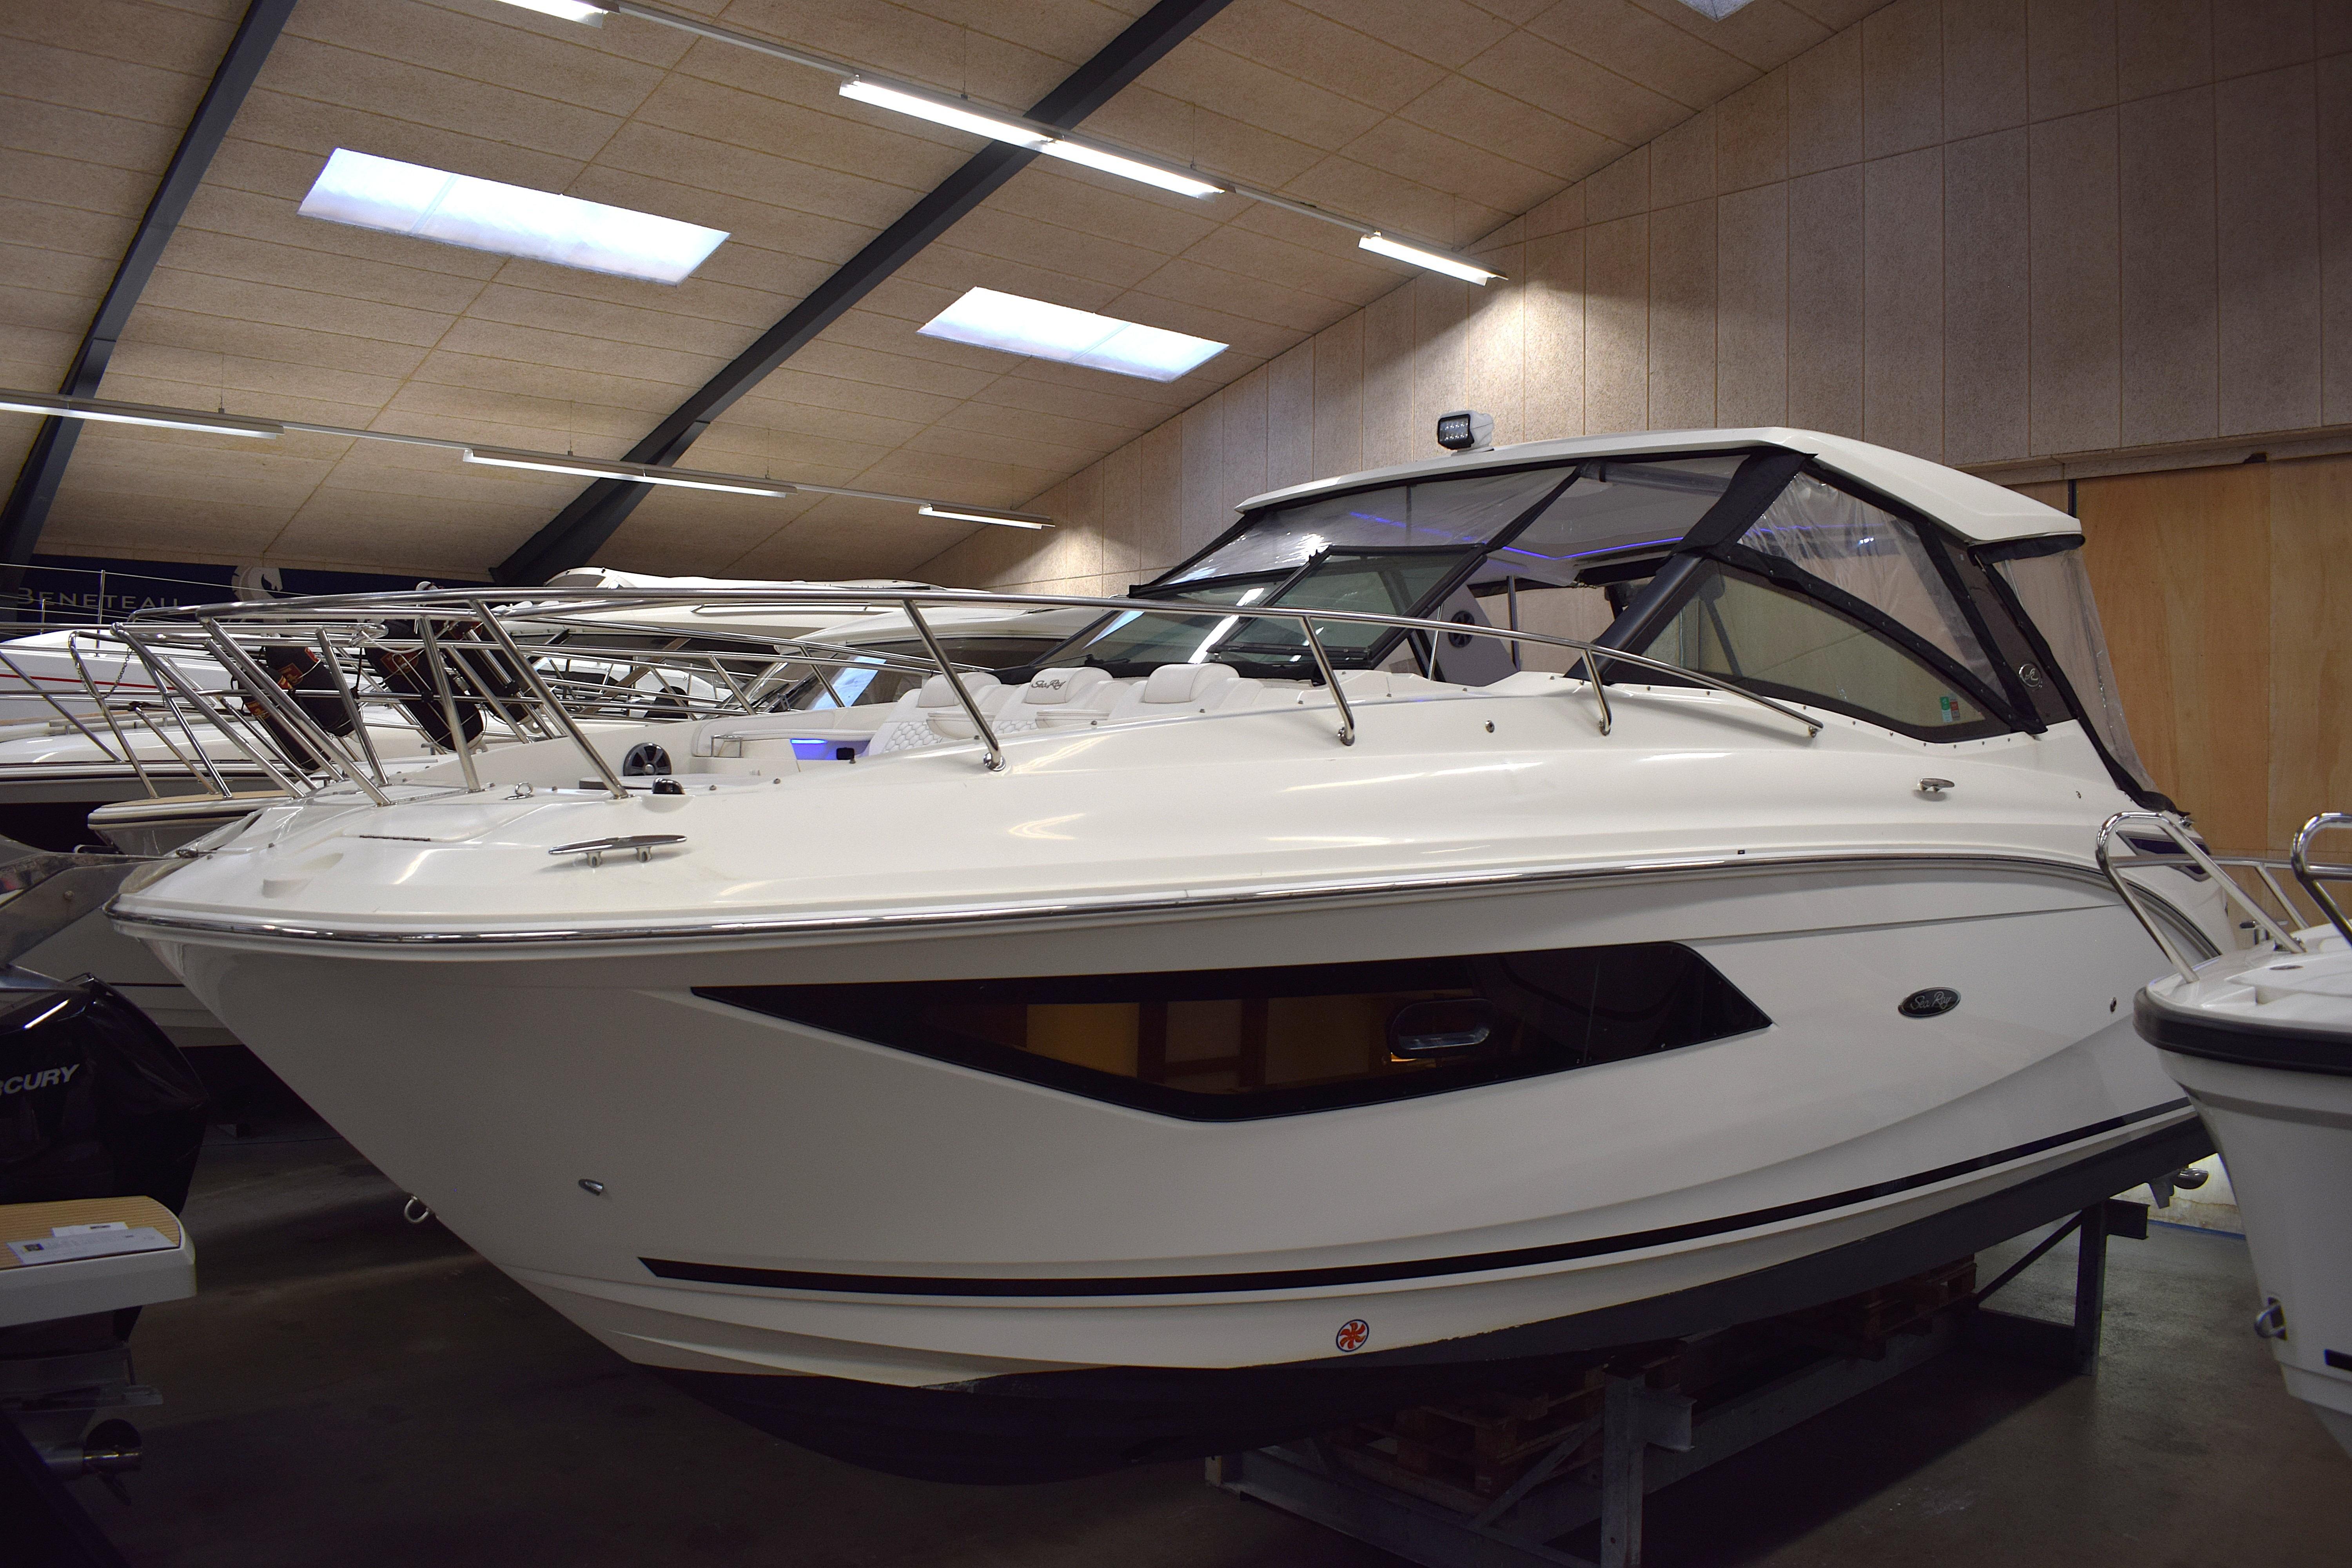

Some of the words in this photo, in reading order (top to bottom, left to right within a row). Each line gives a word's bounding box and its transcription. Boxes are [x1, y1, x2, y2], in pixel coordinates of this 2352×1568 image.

[17, 587, 178, 609] BENETEAU
[1910, 996, 1931, 1010] Sea
[1931, 991, 1952, 1009] Ray
[0, 1063, 80, 1096] CURY
